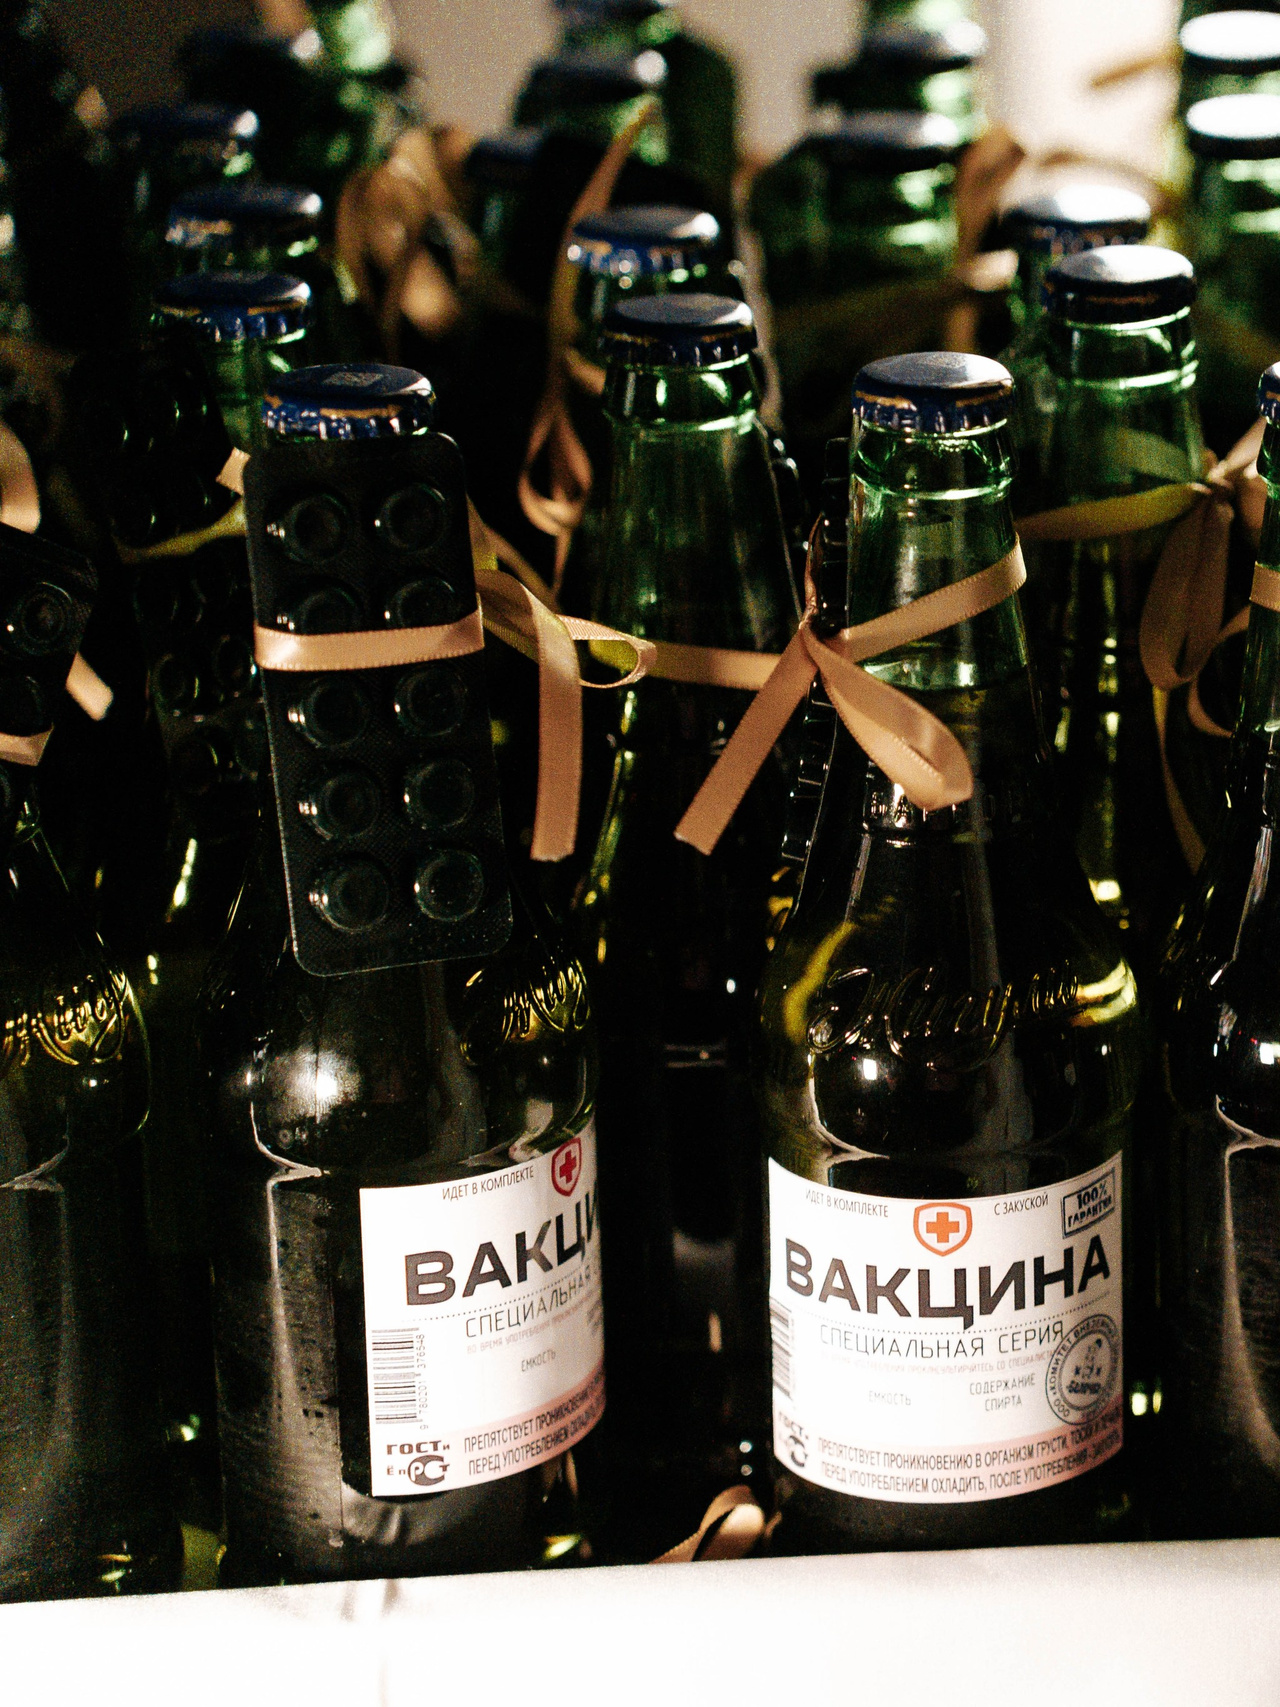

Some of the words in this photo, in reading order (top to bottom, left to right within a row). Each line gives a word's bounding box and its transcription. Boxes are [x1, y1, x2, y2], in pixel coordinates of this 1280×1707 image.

[442, 1183, 469, 1202] ИДЕТ
[472, 1183, 478, 1195] В
[480, 1166, 534, 1193] КОМПЛЕКТЕ
[1077, 1180, 1107, 1209] 100%
[805, 1187, 826, 1207] ИДЕТ
[827, 1194, 832, 1207] В
[834, 1197, 889, 1218] КОМПЛЕКТЕ
[994, 1201, 1000, 1216] С
[1002, 1191, 1049, 1215] ЗАКУСКОЙ
[785, 1234, 1111, 1331] ВАКЦИНА
[820, 1324, 984, 1359] СПЕЦИАЛЬНАЯ
[998, 1320, 1064, 1354] СЕРИЯ
[868, 1389, 912, 1407] ЕМКОСТЬ
[969, 1373, 1036, 1395] СОДЕРЖАНИЕ
[984, 1395, 1022, 1412] СПИРТА
[464, 1418, 534, 1453] ПРЕПЯТСТВУЕТ
[468, 1453, 502, 1476] ПЕРЕД
[818, 1437, 881, 1467] ПРЕПЯТСТВУЕТ
[883, 1452, 973, 1471] ПРОНИКНОВЕНИЮ
[975, 1452, 982, 1467] В
[984, 1443, 1034, 1466] ОРГАНИЗМ
[821, 1461, 847, 1484] ПЕРЕД
[848, 1470, 929, 1493] УПОТРЕБЛЕНИЕМ
[931, 1476, 987, 1494] ОХЛАДИТЬ,
[989, 1470, 1021, 1489] ПОСЛЕ
